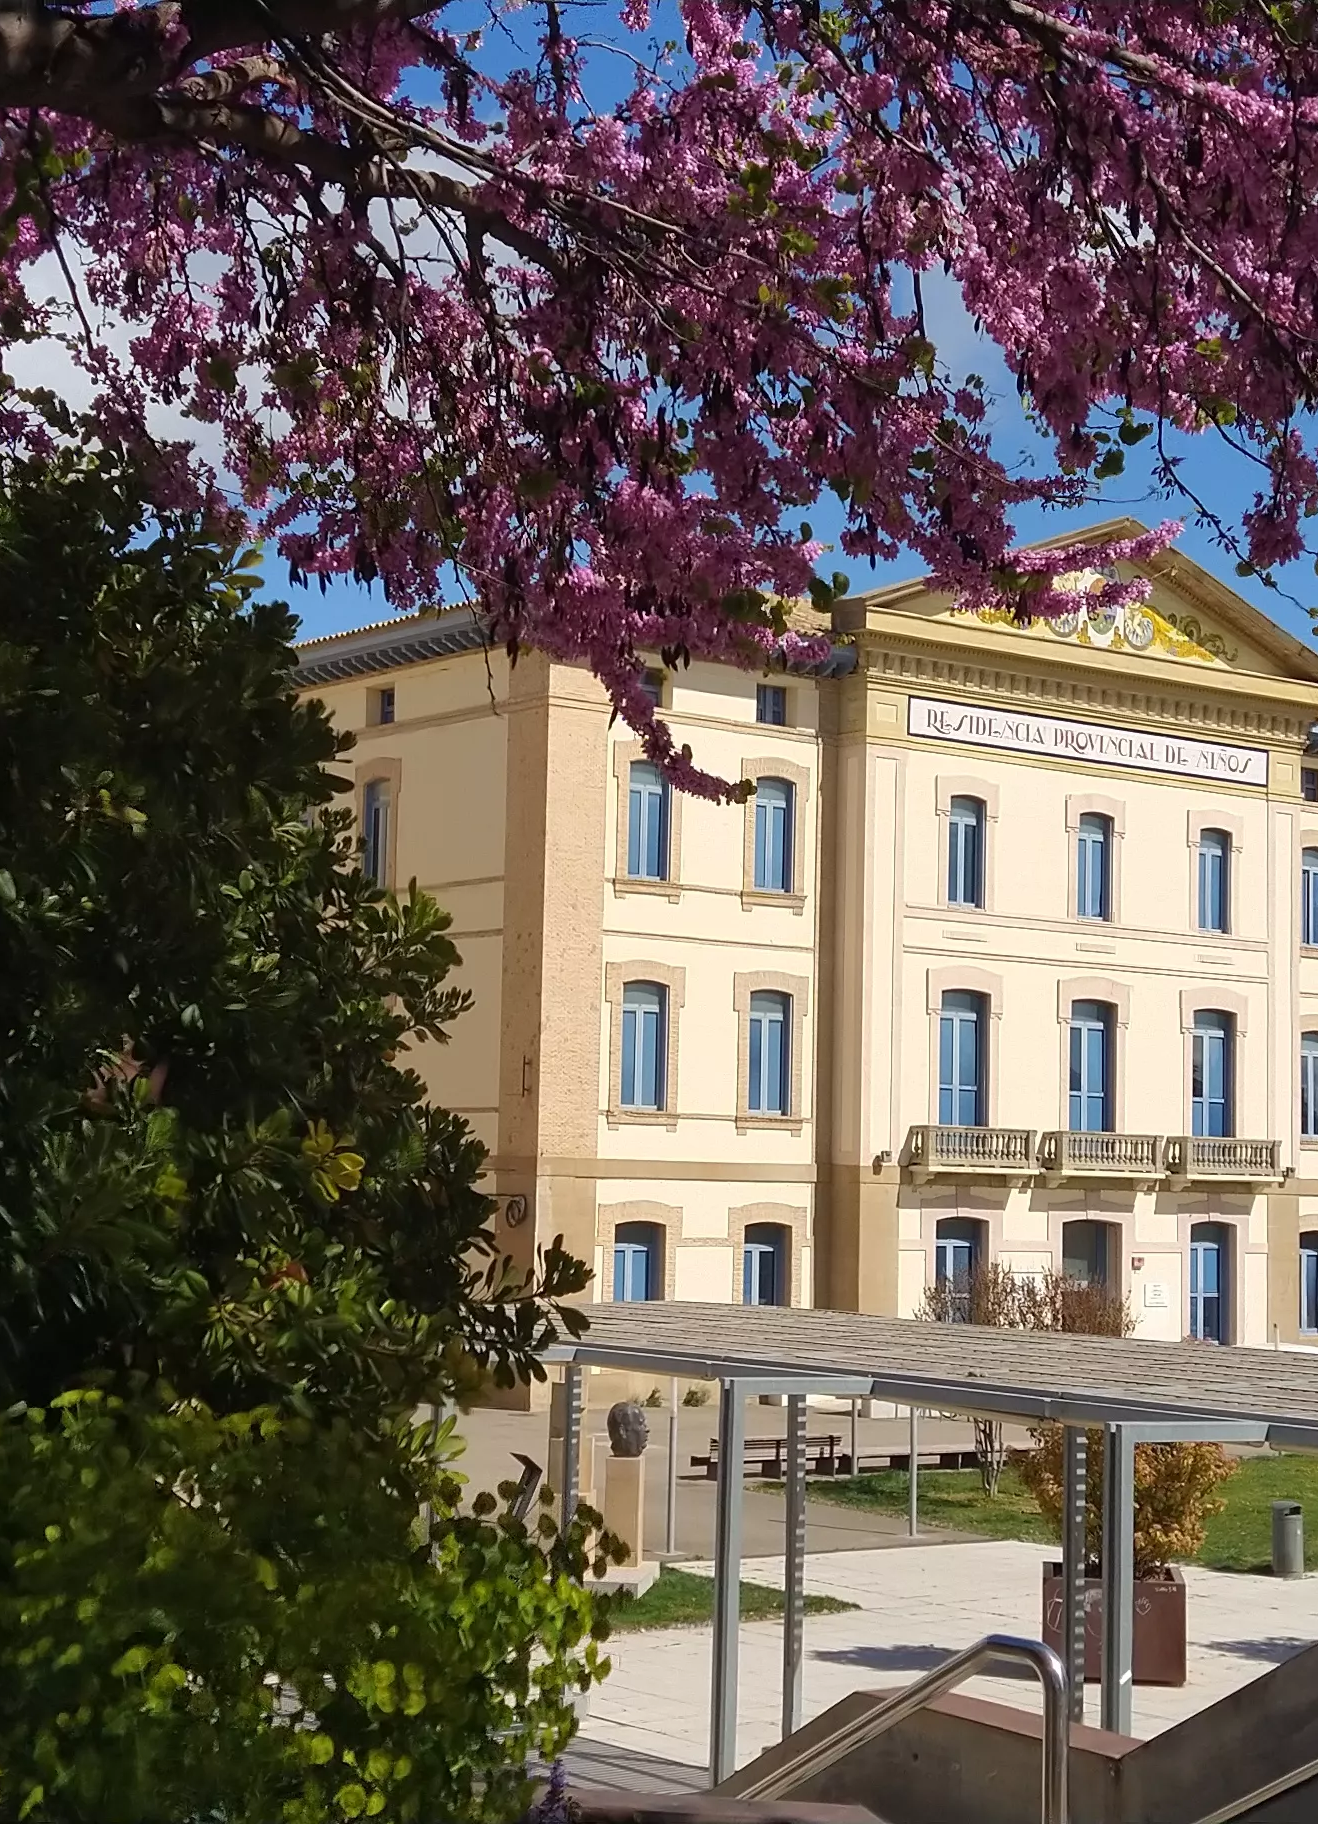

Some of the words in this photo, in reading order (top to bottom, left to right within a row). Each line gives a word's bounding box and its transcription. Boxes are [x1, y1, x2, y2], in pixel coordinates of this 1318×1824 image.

[926, 708, 1045, 745] RESIDENCIA
[1054, 728, 1159, 762] PROVINCIAL
[1165, 744, 1190, 766] DE
[1195, 748, 1252, 774] NIÑOS
